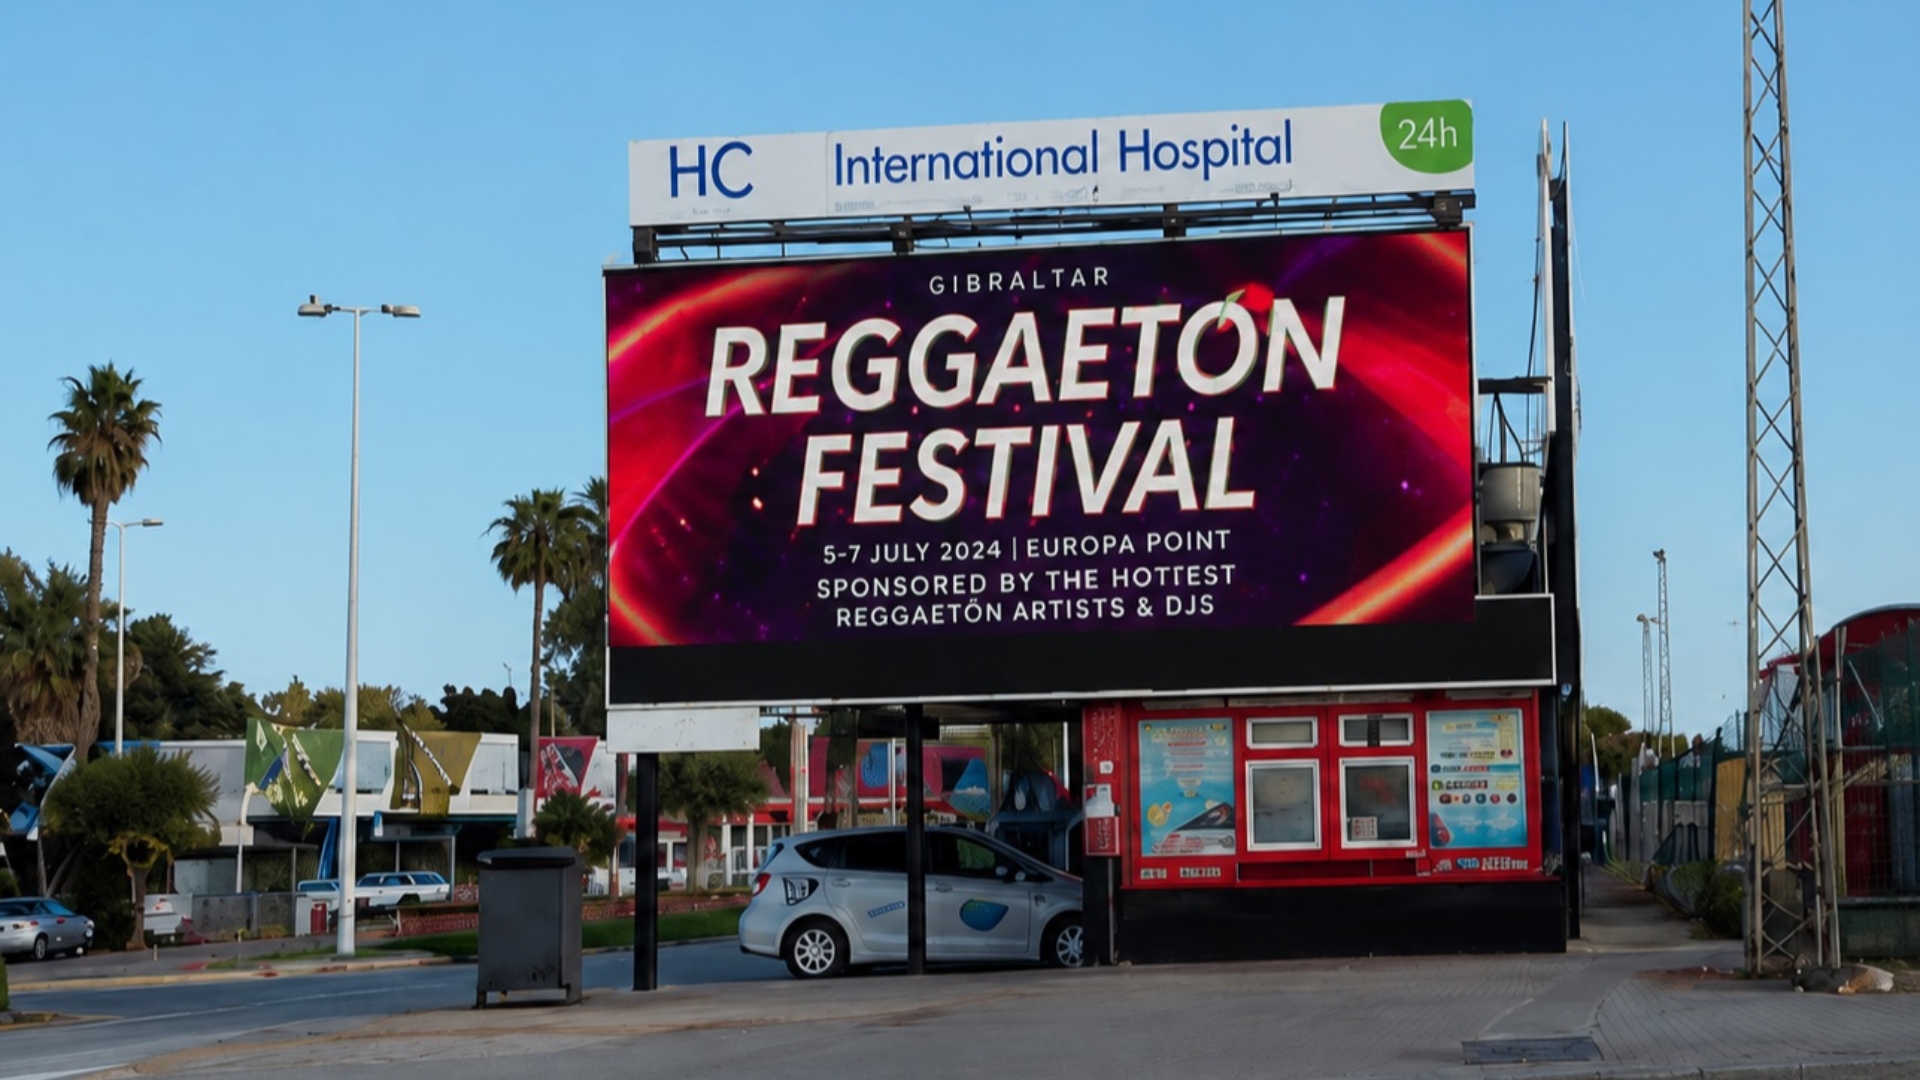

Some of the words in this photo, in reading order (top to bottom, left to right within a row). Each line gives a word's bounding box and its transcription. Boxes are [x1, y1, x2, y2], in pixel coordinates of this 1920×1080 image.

[669, 140, 754, 200] HC
[835, 128, 1099, 186] International
[1118, 118, 1293, 182] Hospital
[1398, 117, 1458, 149] 24h
[929, 266, 1110, 295] GIBRALTAR
[797, 416, 1255, 526] FESTIVAL
[823, 544, 861, 564] 5-7
[870, 542, 930, 564] JULY
[940, 540, 1002, 561] 2024
[1027, 535, 1135, 558] EUROPA
[1147, 529, 1231, 553] POINT
[817, 574, 987, 599] SPONSORED
[1000, 572, 1034, 593] BY
[1045, 568, 1099, 591] THE
[1112, 564, 1236, 588] HOTTEST
[1012, 597, 1125, 621] ARTISTS
[1136, 596, 1153, 617] &
[1166, 594, 1214, 616] DJS
